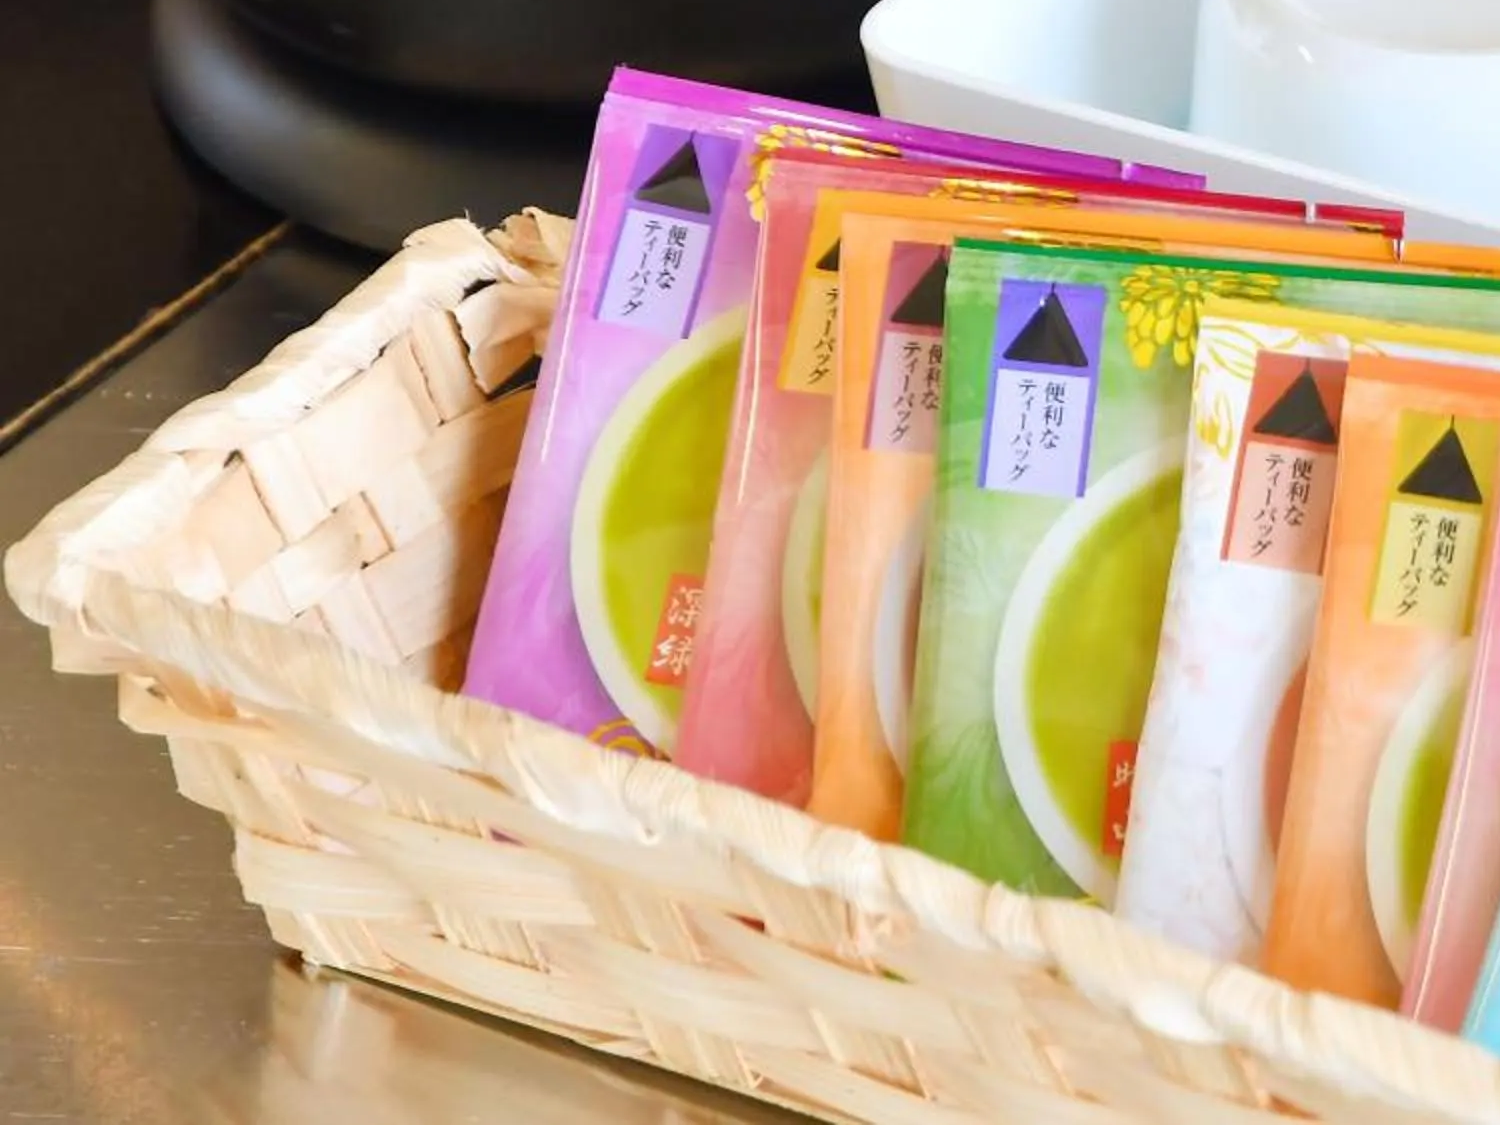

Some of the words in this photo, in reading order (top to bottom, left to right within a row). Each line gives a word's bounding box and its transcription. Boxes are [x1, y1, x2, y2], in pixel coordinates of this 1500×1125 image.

[655, 225, 688, 290] 便利な
[1039, 382, 1067, 449] 便利な
[1284, 458, 1315, 527] 便利な
[1429, 517, 1459, 588] 便利な
